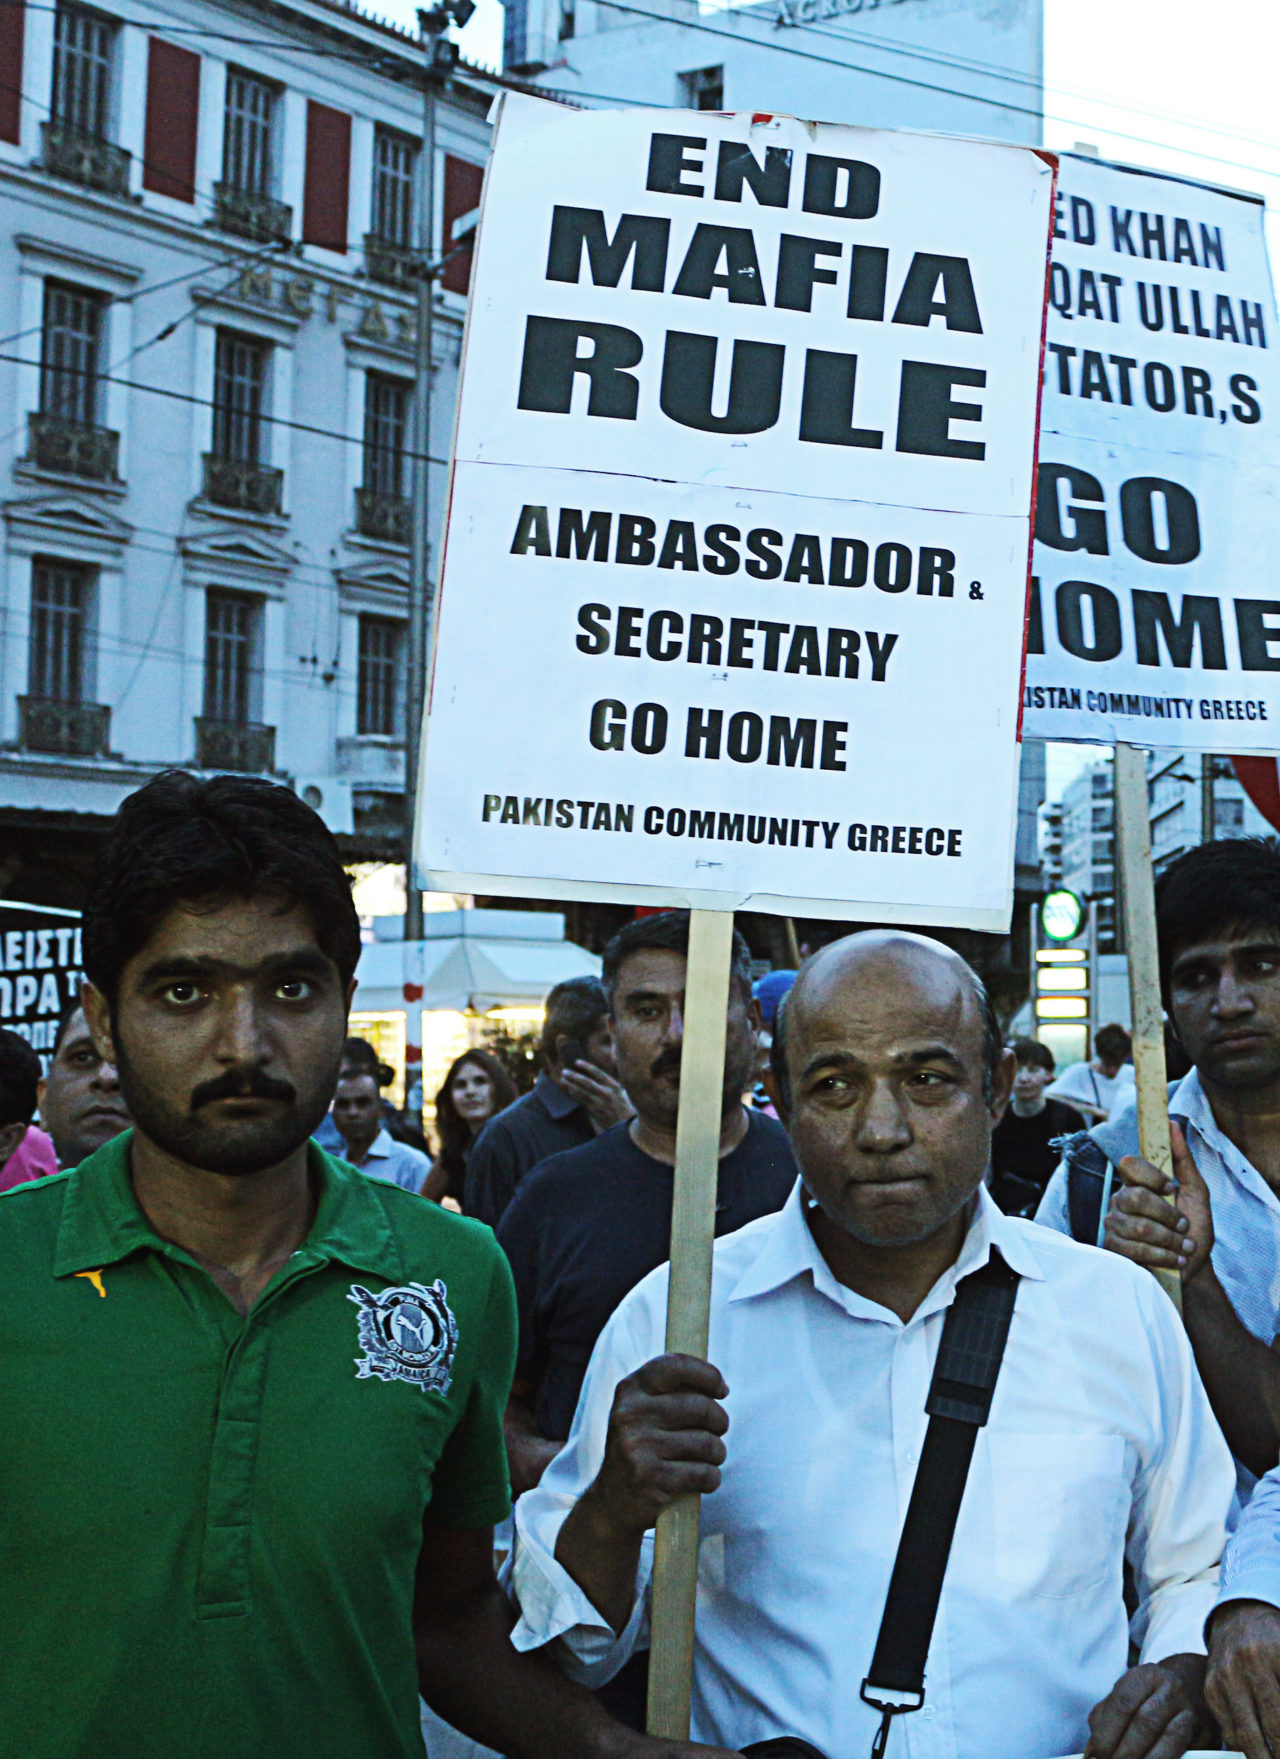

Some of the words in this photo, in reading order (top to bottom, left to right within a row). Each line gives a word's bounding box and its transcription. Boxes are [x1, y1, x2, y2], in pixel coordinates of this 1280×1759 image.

[645, 132, 881, 219] END
[545, 204, 983, 334] MAFIA
[1110, 205, 1226, 272] KHAN
[1136, 281, 1268, 349] ULLAH
[517, 315, 987, 461] RULE
[1042, 341, 1262, 425] TATOR,S
[510, 505, 956, 597] AMBASSADOR
[969, 581, 985, 601] &
[1034, 461, 1201, 566] GO
[575, 602, 898, 682] SECRETARY
[589, 699, 667, 755] GO
[685, 709, 849, 772] HOME
[1023, 686, 1082, 710] ISTAN
[1086, 690, 1194, 719] COMMUNITY
[1199, 699, 1269, 721] GREECE
[482, 794, 634, 833] PAKISTAN
[643, 807, 838, 850] COMMUNITY
[847, 823, 963, 857] GREECE
[0, 928, 83, 971] ΕΙΣΤ
